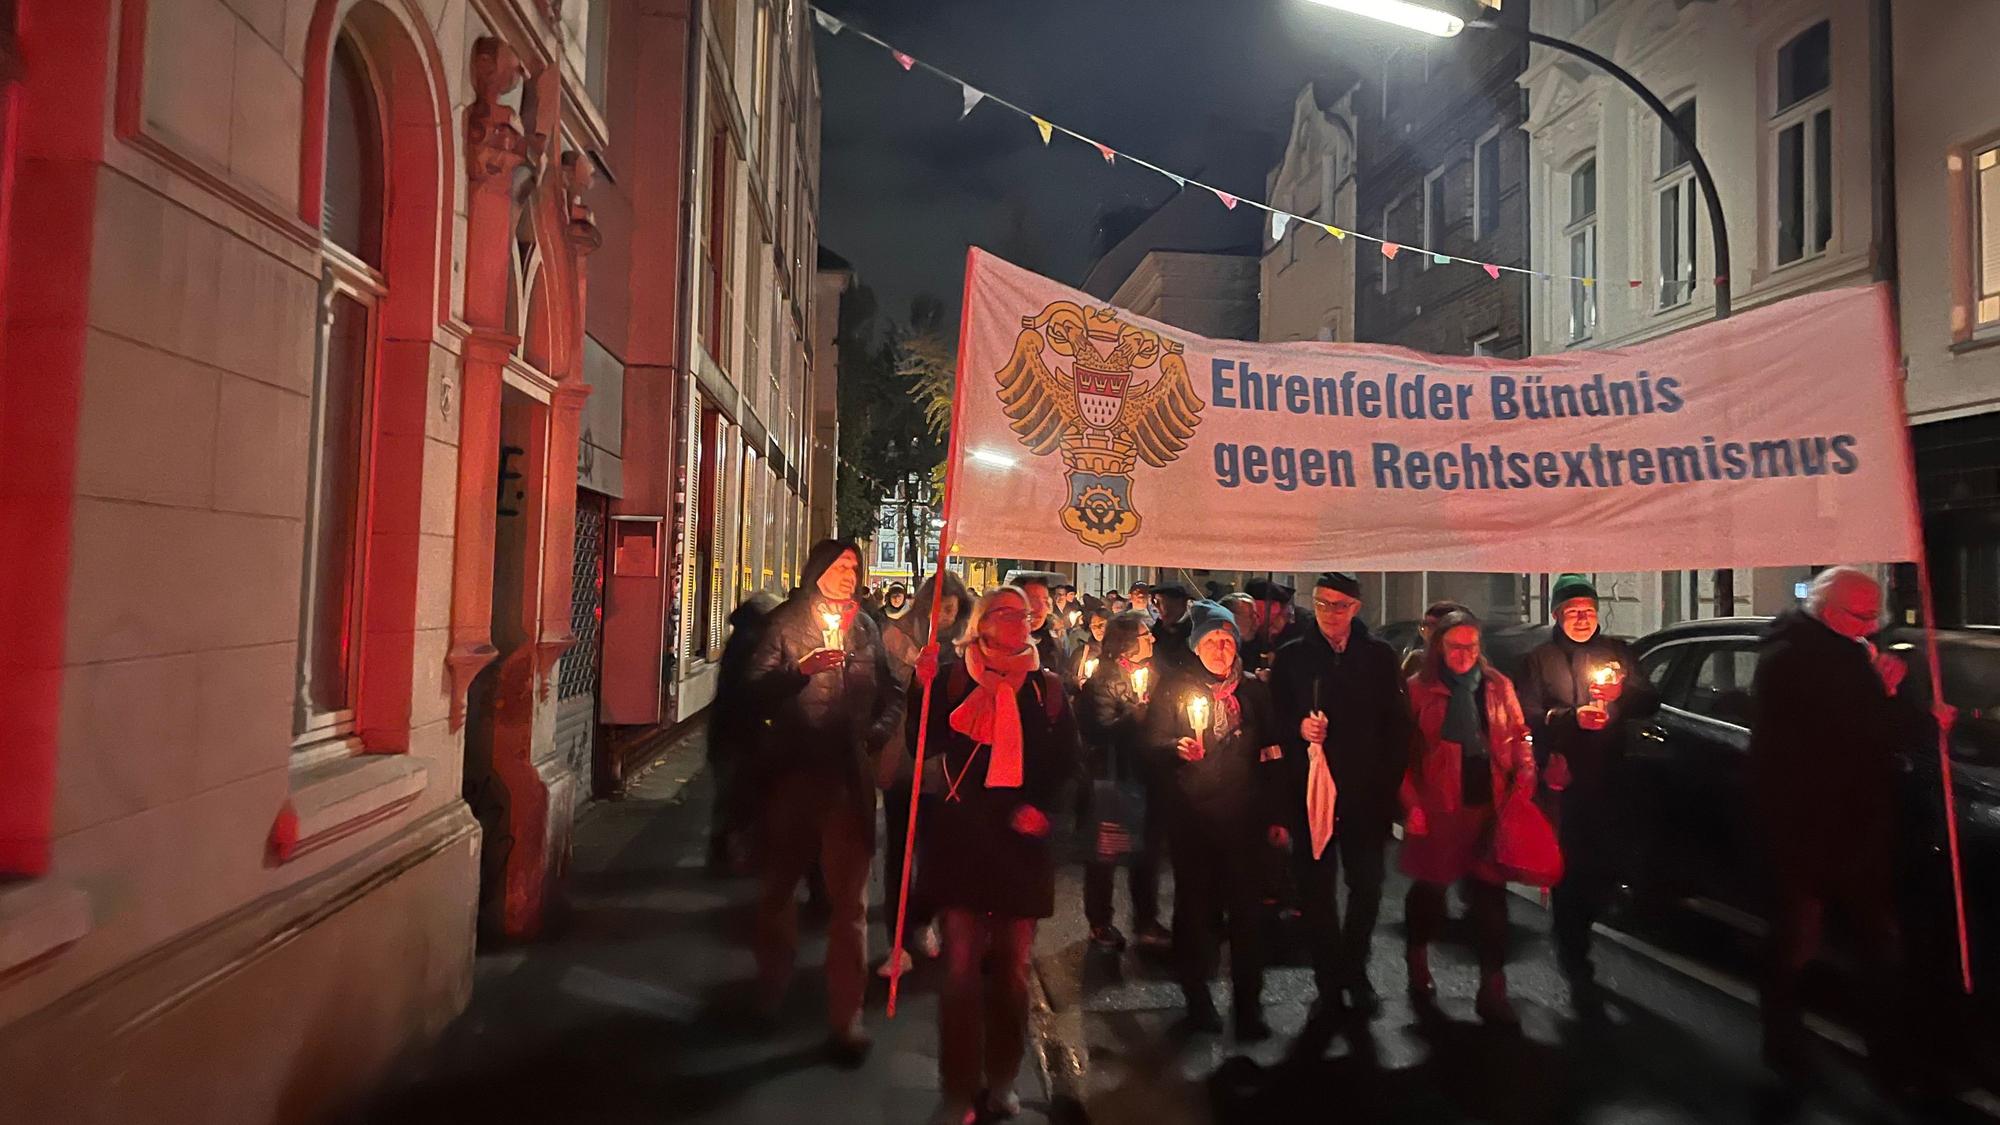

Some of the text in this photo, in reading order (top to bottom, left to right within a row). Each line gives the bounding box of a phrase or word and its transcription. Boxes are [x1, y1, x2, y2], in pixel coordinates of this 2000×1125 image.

[1211, 357, 1686, 421] Ehrenfelder Bündnis
[1213, 433, 1860, 492] gegen Rechtsextremismus
